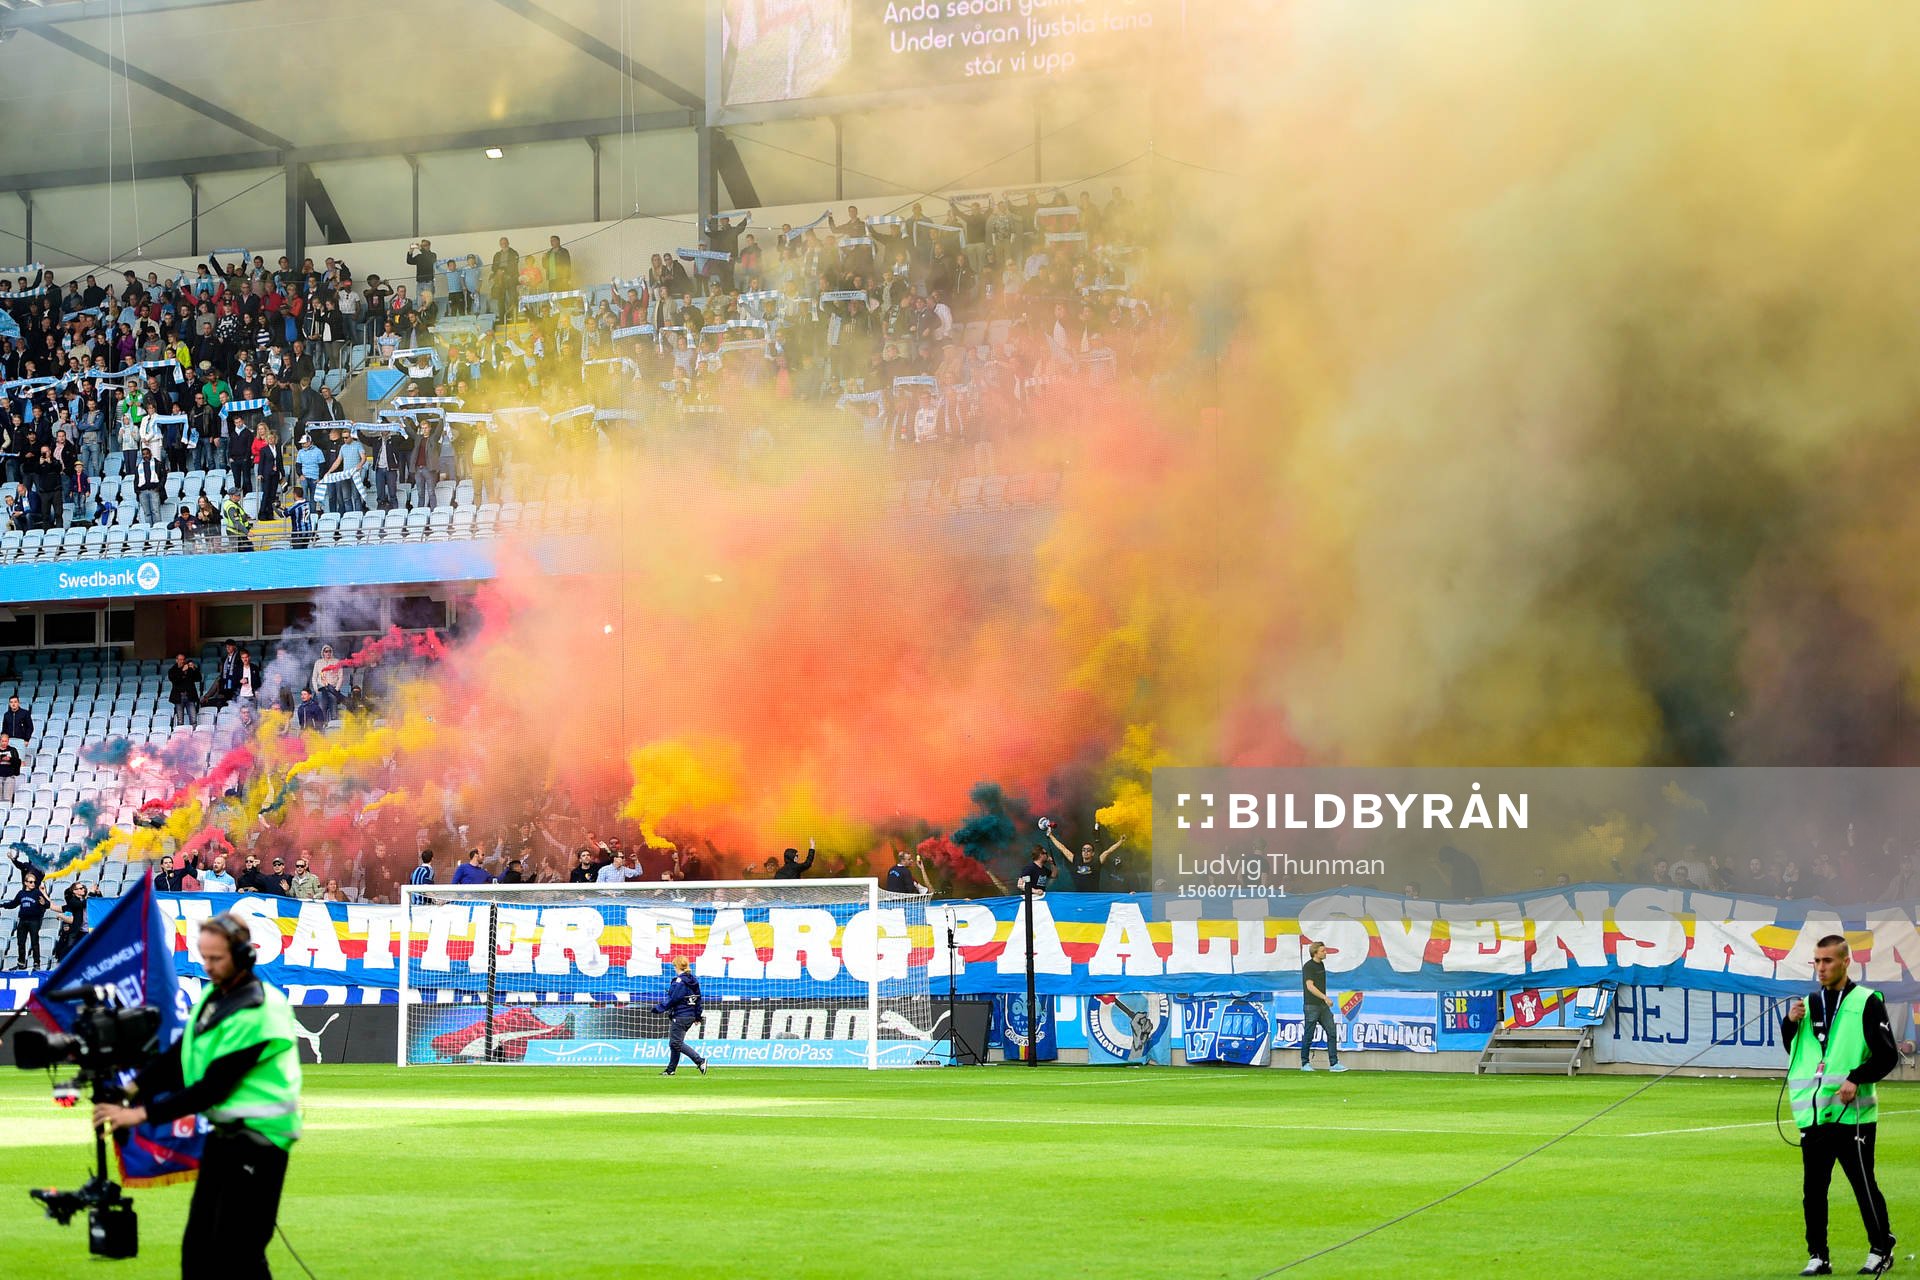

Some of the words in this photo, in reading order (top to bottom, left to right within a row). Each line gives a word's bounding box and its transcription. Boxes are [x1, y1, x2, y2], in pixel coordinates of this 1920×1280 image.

[890, 32, 954, 54] Under
[961, 25, 1019, 47] våran
[965, 53, 1002, 77] står
[1009, 52, 1026, 72] vi
[1033, 51, 1075, 74] upp
[59, 569, 135, 589] Swedbank
[1184, 1000, 1218, 1032] DIF
[1614, 984, 1690, 1044] HEJ
[1184, 1032, 1217, 1061] L27
[1352, 1022, 1434, 1047] CALLING
[732, 1043, 768, 1059] med
[772, 1043, 833, 1061] BroPass
